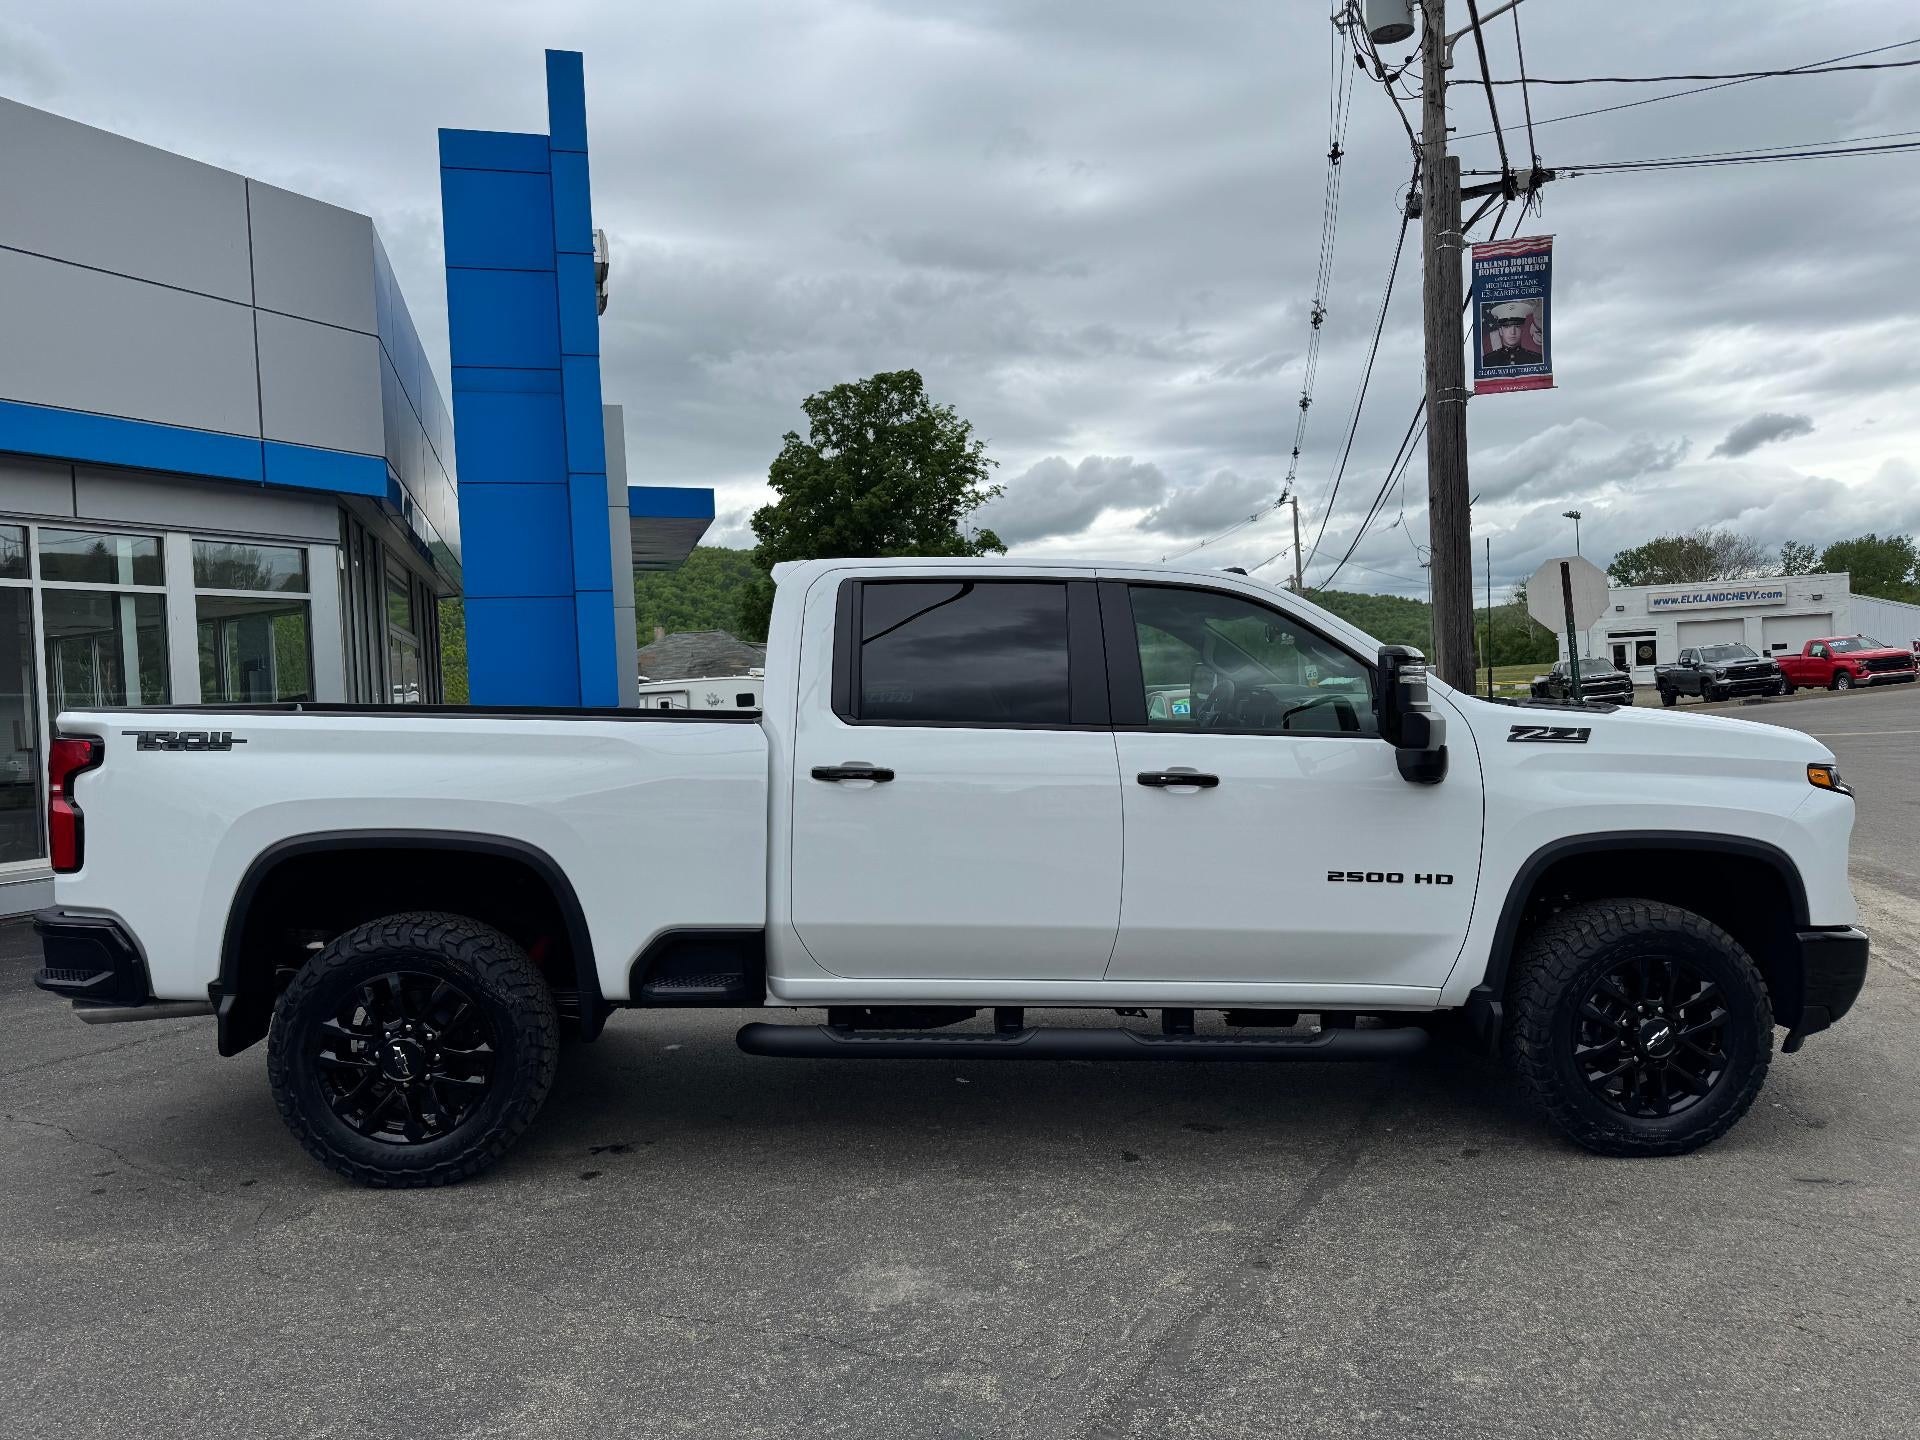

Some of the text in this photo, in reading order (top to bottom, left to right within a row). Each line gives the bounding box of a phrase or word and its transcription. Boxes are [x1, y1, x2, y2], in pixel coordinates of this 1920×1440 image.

[1475, 256, 1549, 269] ELKLAND BOROUGH
[1478, 264, 1546, 276] HOMETOWN HERO
[1653, 590, 1783, 606] www.ELKLANDCHEVY.com
[1327, 870, 1454, 885] 2500 HD
